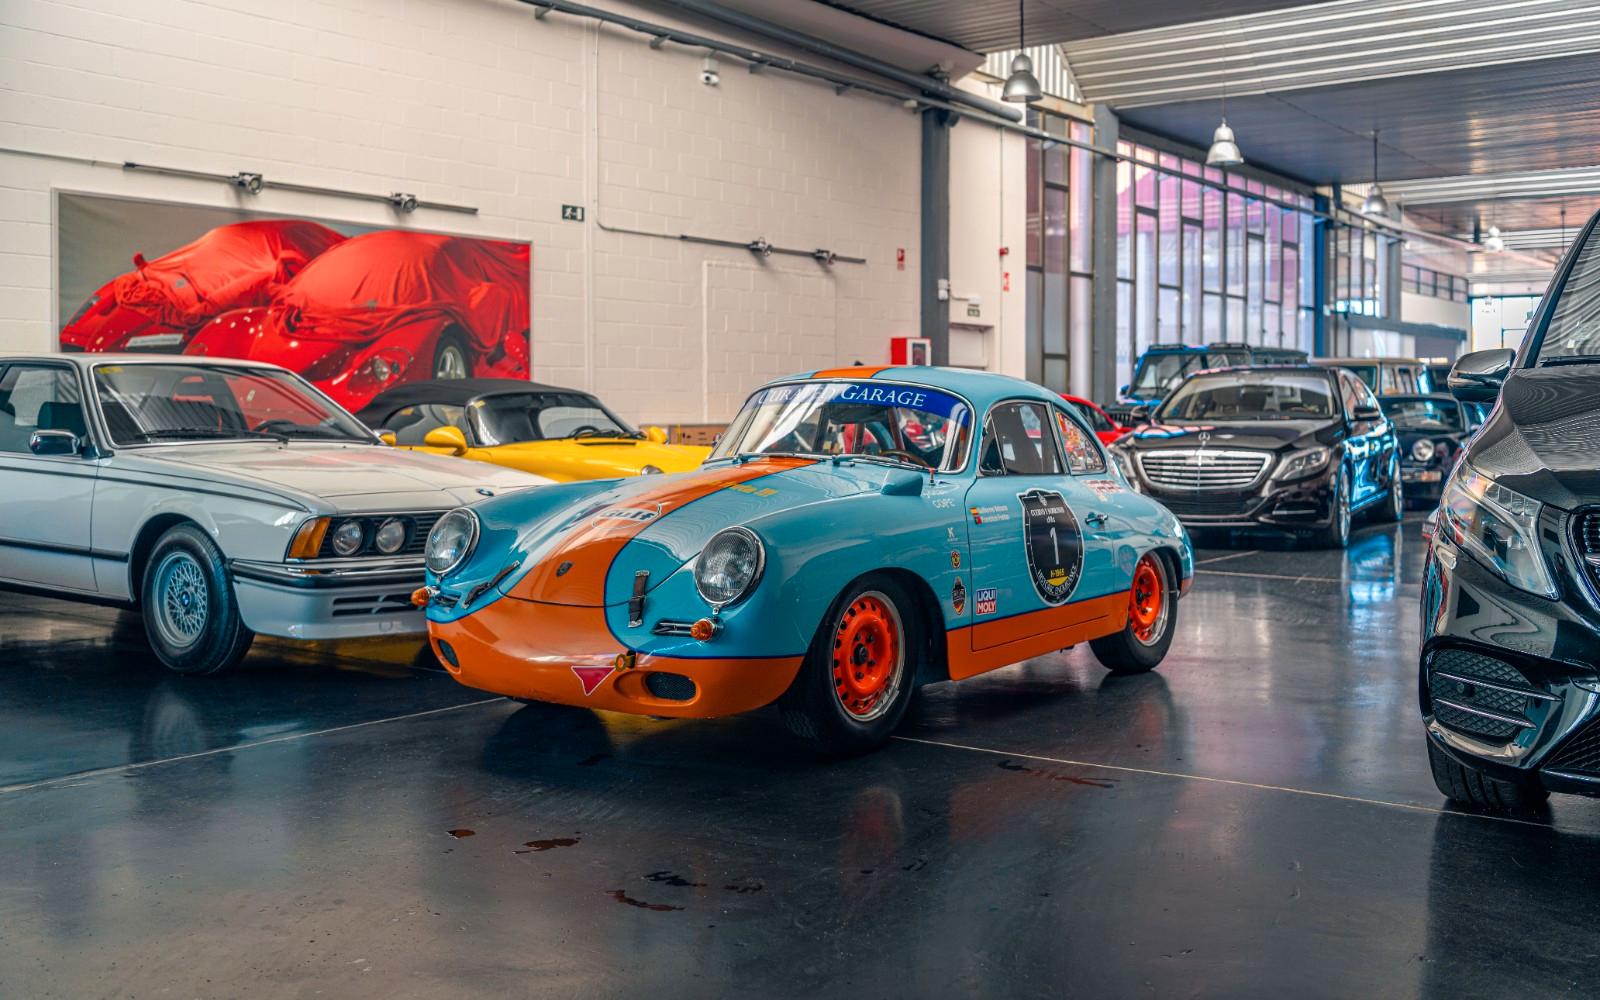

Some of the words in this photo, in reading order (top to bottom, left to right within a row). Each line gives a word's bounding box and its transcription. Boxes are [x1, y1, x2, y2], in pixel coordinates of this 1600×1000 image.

[758, 387, 836, 404] CURAED
[840, 384, 927, 407] GARAGE
[1050, 527, 1060, 565] 1
[977, 589, 996, 602] LIQUI
[977, 601, 996, 613] MOLY
